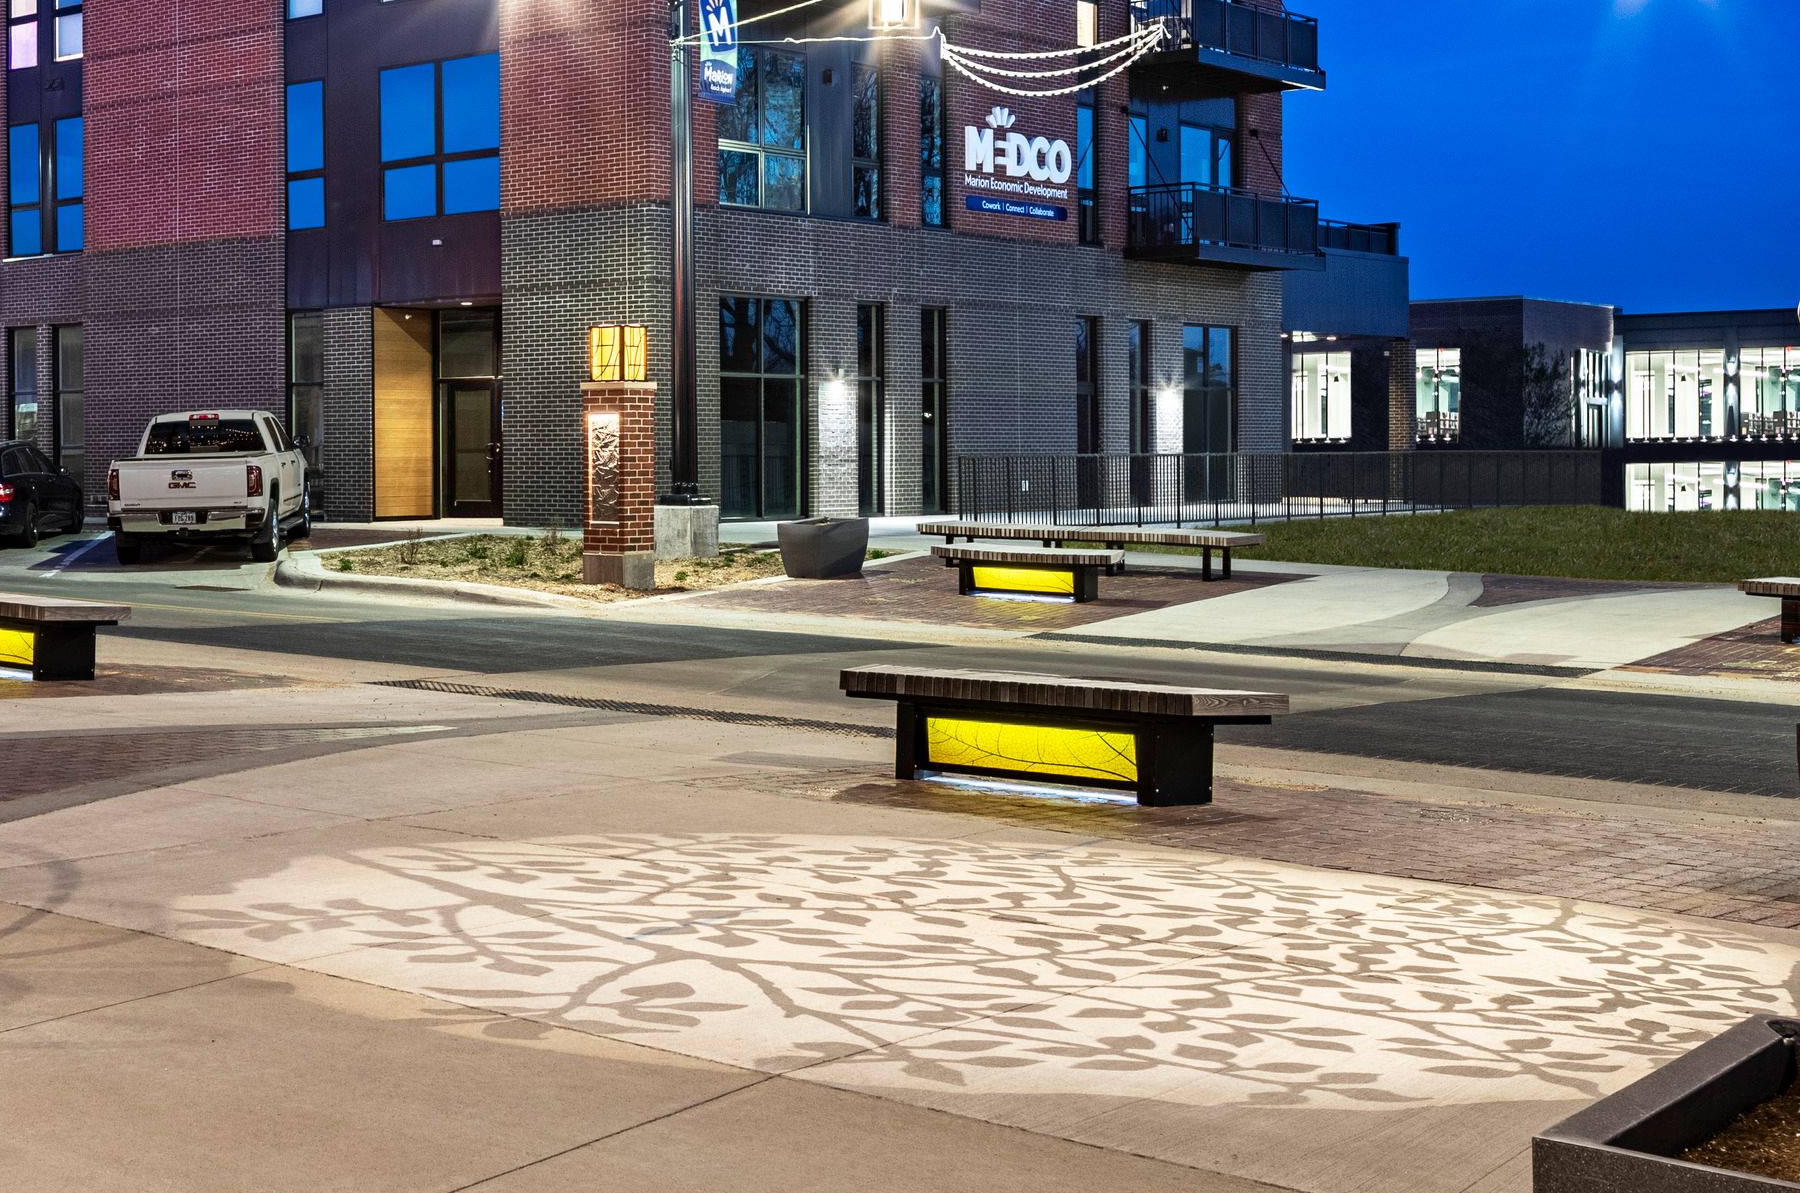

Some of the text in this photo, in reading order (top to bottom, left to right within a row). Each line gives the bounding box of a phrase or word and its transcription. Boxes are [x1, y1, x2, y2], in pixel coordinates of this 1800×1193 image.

[965, 173, 1068, 200] Marion Economic Development
[982, 200, 1055, 217] Cowork Connect Collaborate
